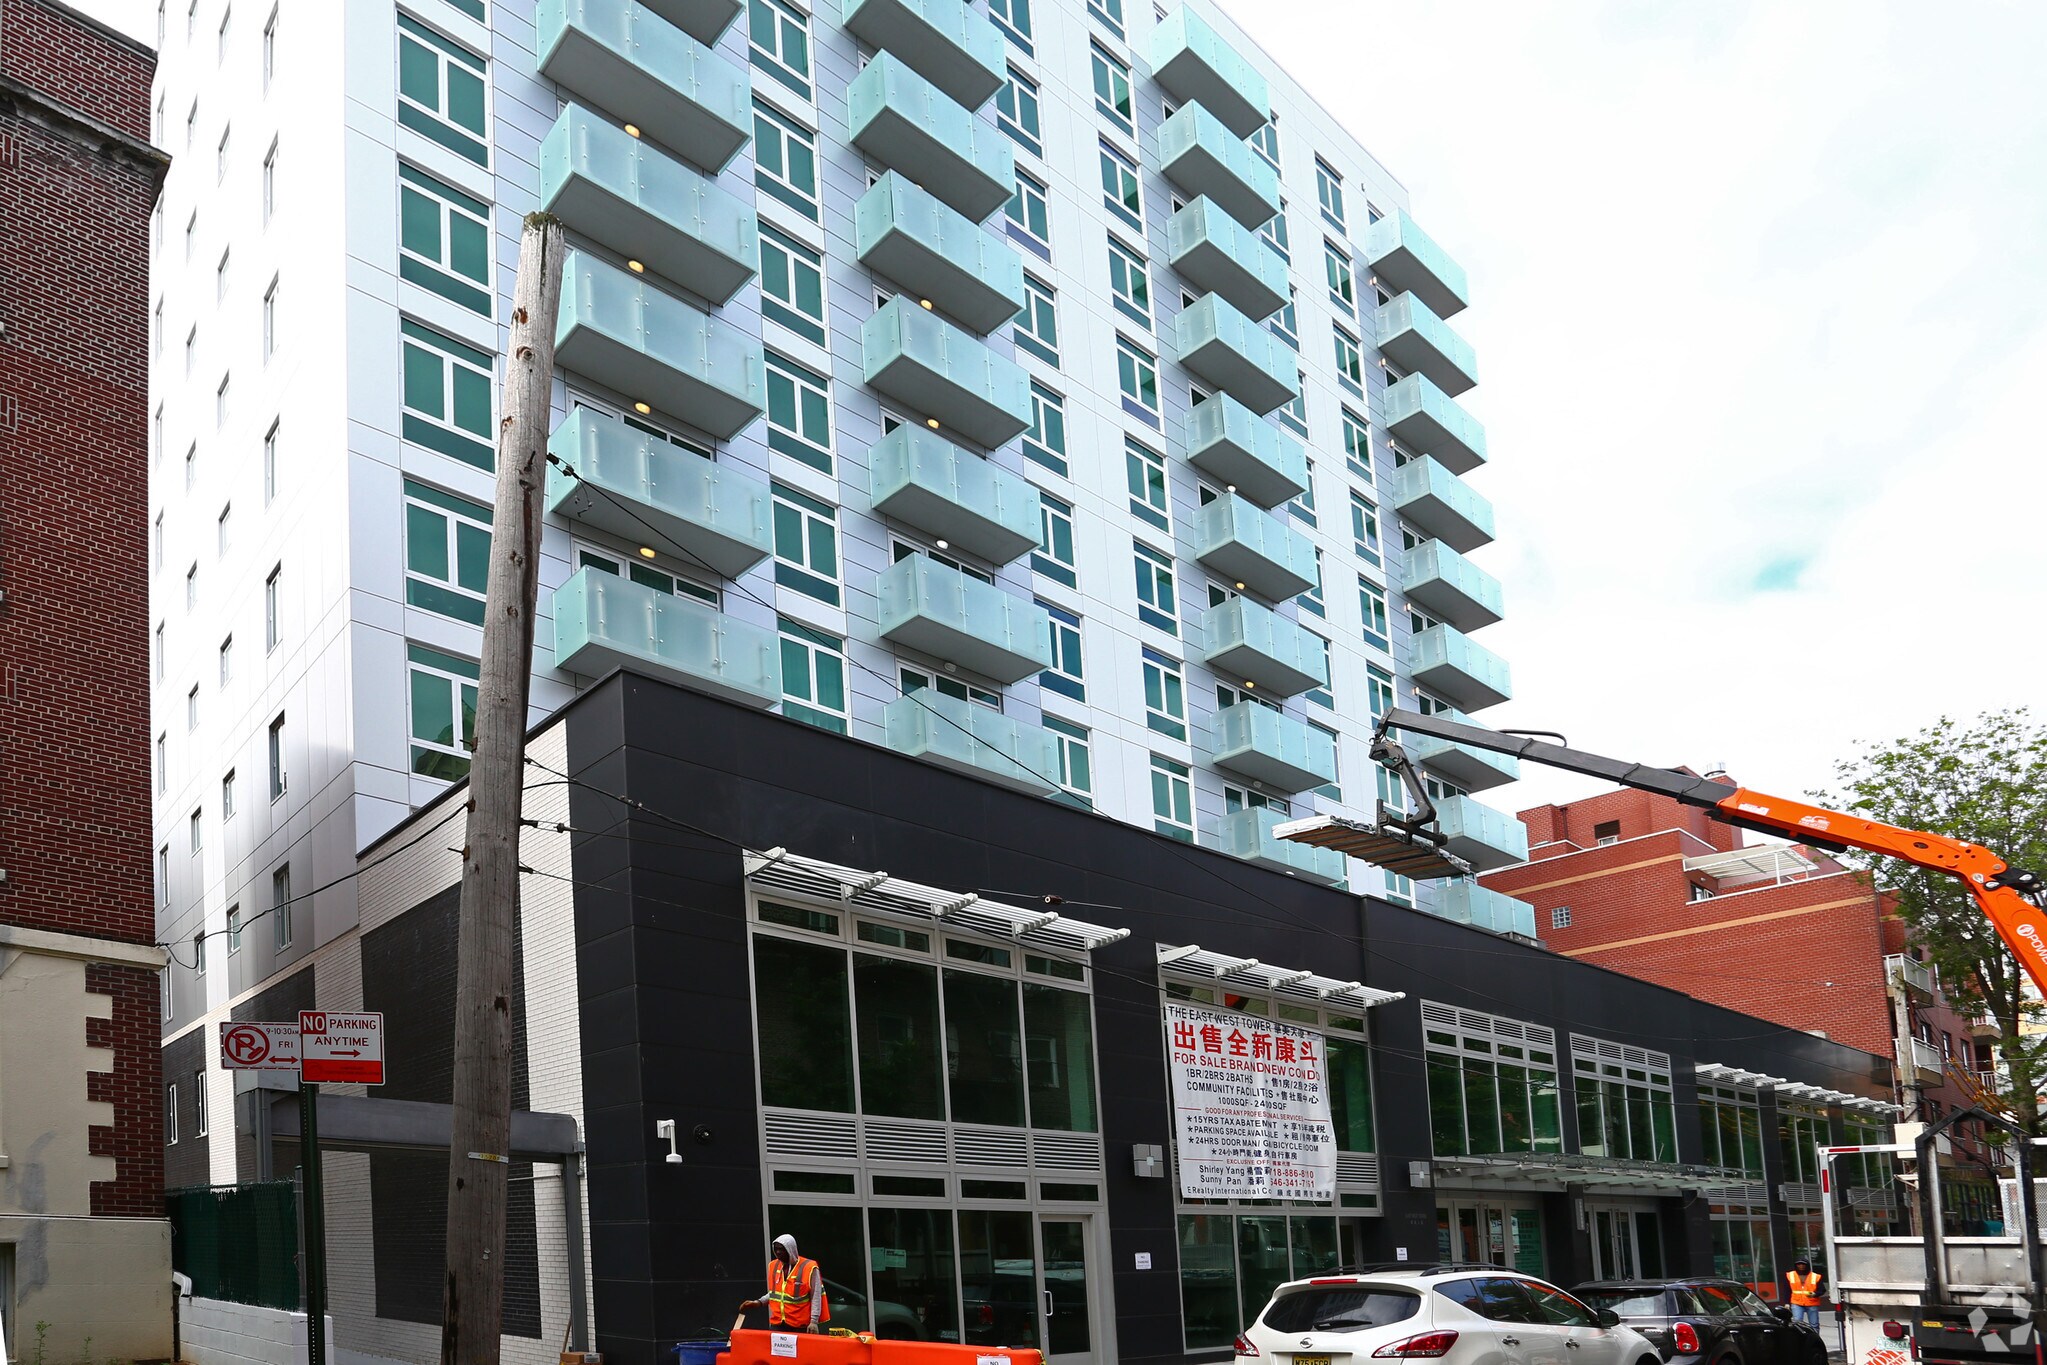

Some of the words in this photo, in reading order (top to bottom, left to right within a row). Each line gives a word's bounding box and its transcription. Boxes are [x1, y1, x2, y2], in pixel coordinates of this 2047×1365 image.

[303, 1015, 326, 1032] NO
[329, 1018, 377, 1030] PARKING
[1168, 1006, 1187, 1019] THE
[1241, 1017, 1271, 1032] TOWER
[278, 1040, 294, 1049] FRI
[314, 1036, 370, 1047] ANYTIME
[1173, 1020, 1318, 1068] 出售全新康斗
[1174, 1052, 1197, 1066] FOR
[1199, 1055, 1227, 1069] SALE
[1186, 1081, 1235, 1095] COMMUNITY
[1220, 1117, 1235, 1126] TAX
[1194, 1126, 1224, 1135] PARKING
[1225, 1127, 1246, 1137] SPACE
[1199, 1164, 1224, 1176] Shirley
[1225, 1166, 1245, 1176] Yang
[1200, 1174, 1223, 1185] Sunny
[1226, 1176, 1242, 1186] Pan
